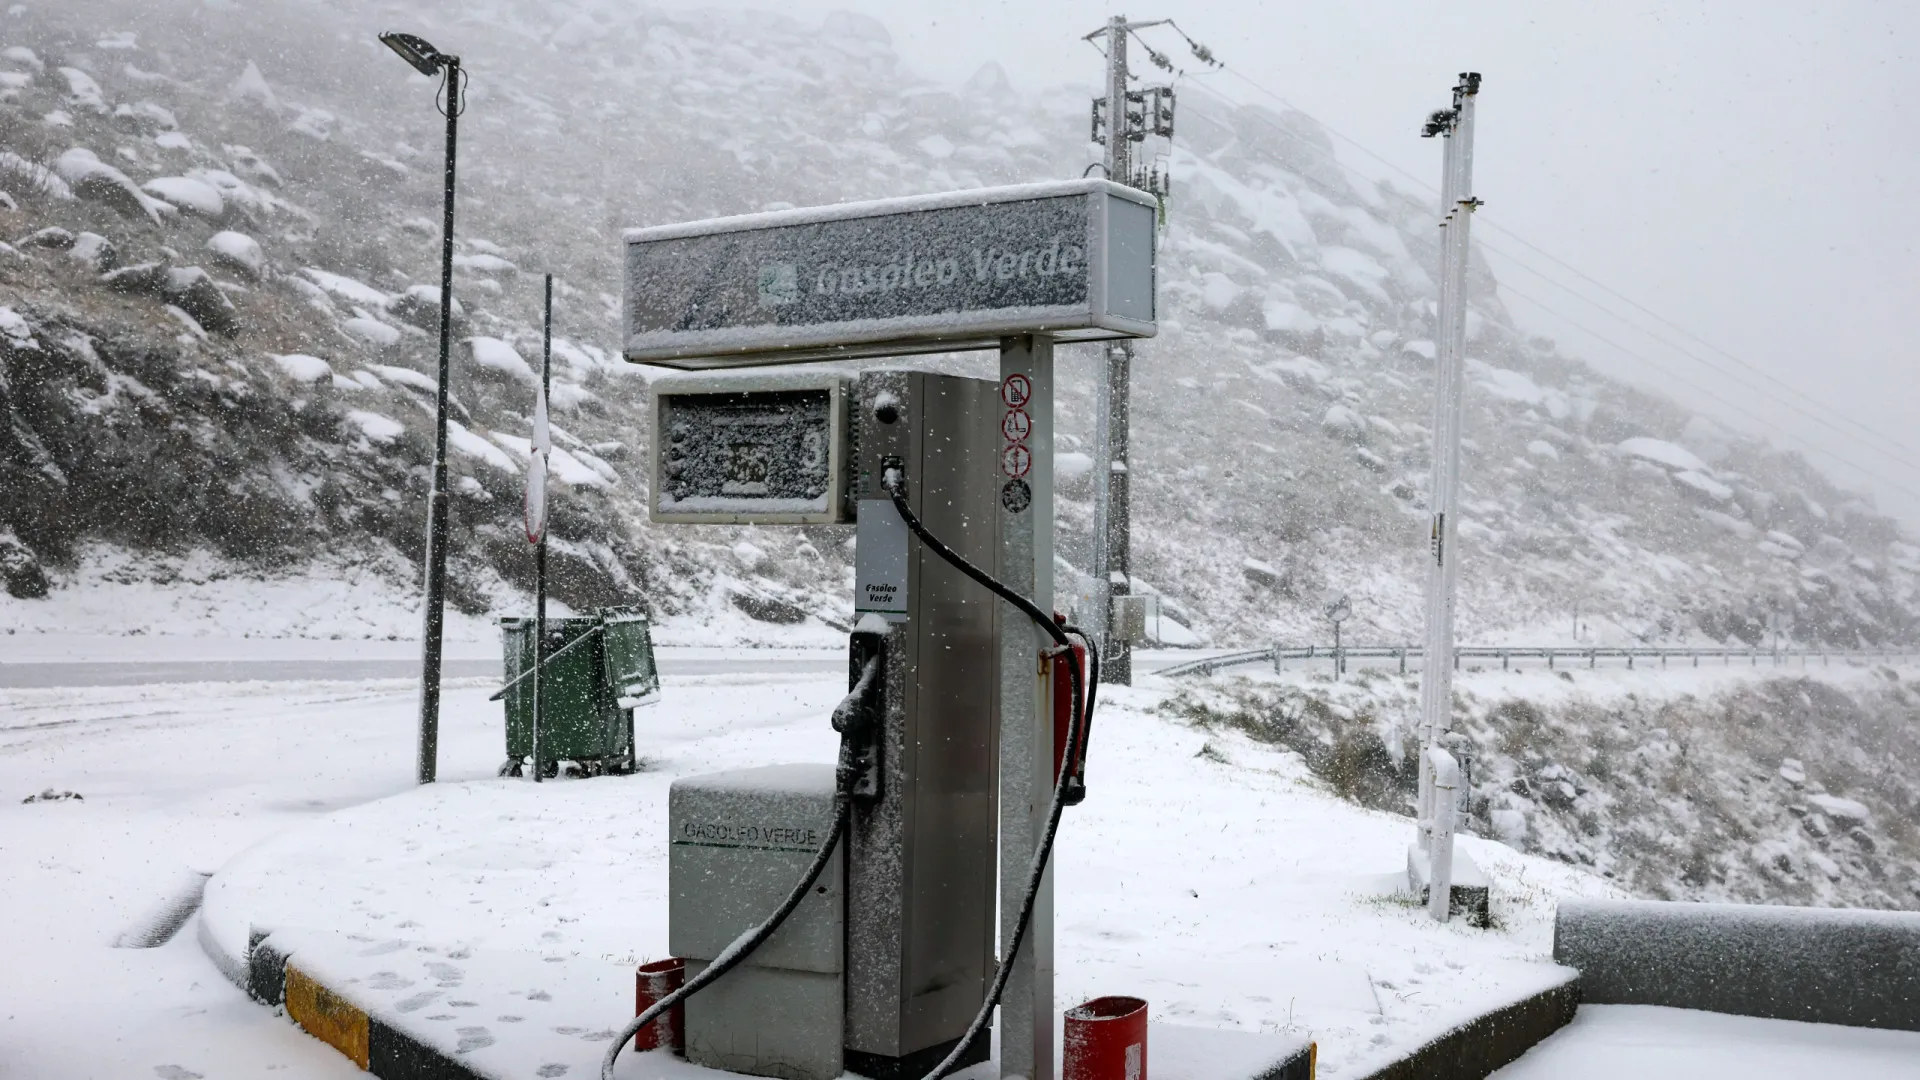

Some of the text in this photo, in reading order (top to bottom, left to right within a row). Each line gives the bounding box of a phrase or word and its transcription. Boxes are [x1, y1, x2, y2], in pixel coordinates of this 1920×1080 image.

[971, 234, 1083, 282] Verde
[869, 593, 893, 603] Verde
[763, 827, 817, 845] VERDE
